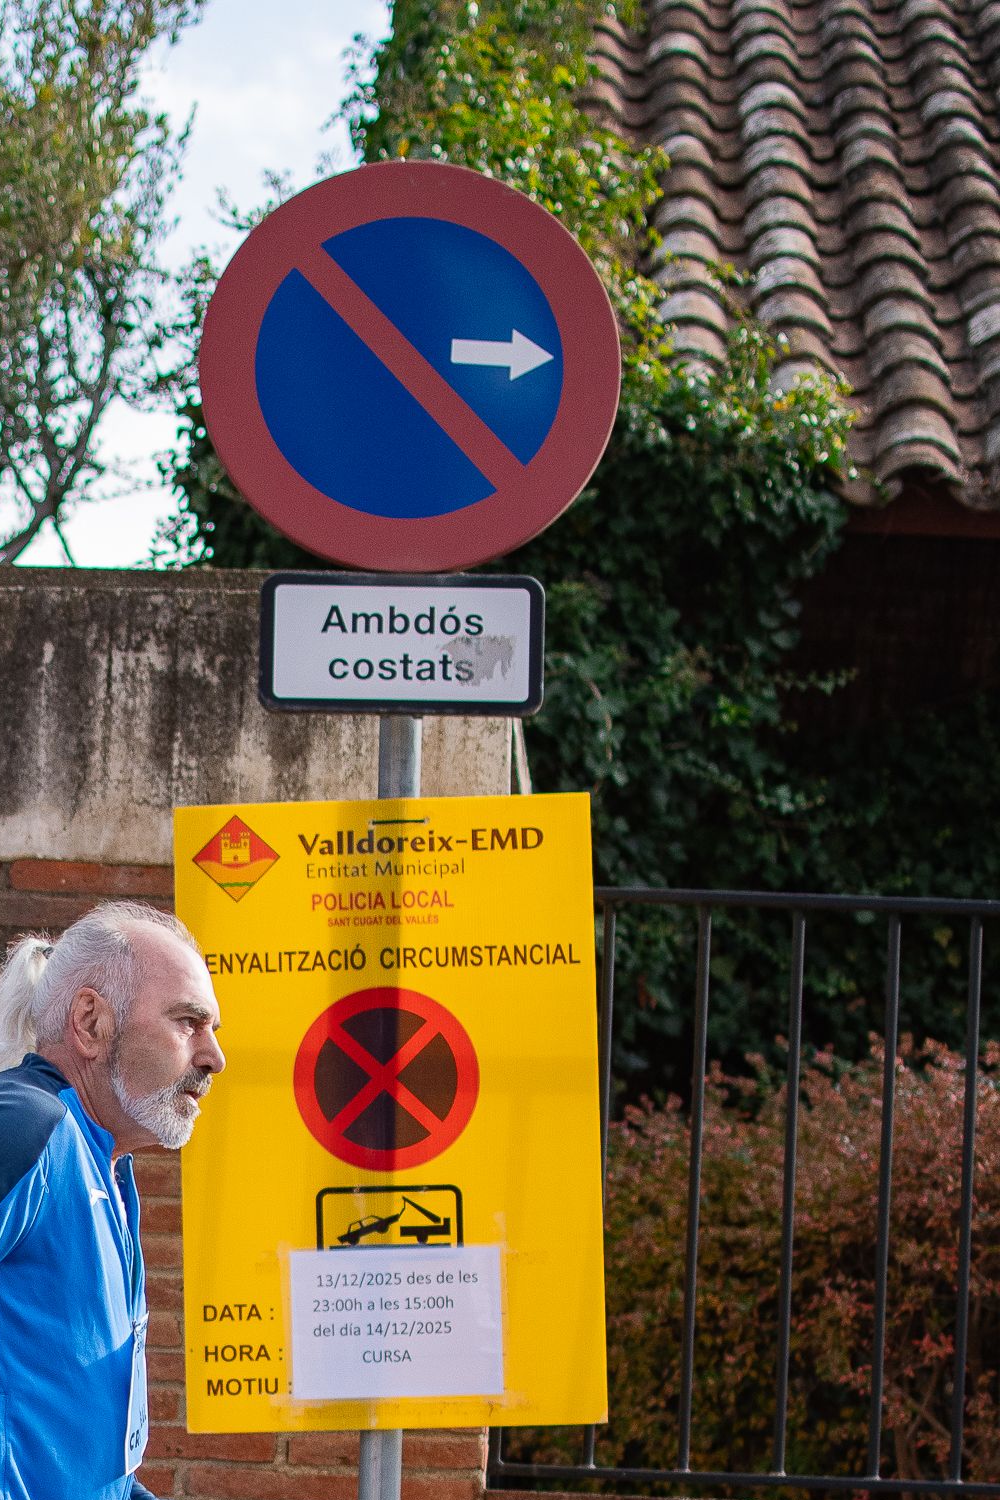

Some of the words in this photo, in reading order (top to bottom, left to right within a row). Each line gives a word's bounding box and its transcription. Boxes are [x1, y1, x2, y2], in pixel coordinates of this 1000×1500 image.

[321, 603, 485, 636] Ambdós
[328, 652, 476, 682] costats
[297, 827, 545, 856] Valldoreix-EMD
[306, 862, 367, 880] Entitat
[374, 858, 466, 879] Municipal
[311, 891, 386, 912] POLICIA
[391, 890, 455, 909] LOCAL
[327, 917, 351, 928] SANT
[353, 916, 383, 927] CUGAT
[385, 915, 401, 926] DEL
[204, 943, 367, 975] ENYALITZACIÓ
[379, 943, 582, 969] CIRCUMSTANCIAL
[316, 1272, 403, 1288] 13/12/2025
[406, 1271, 432, 1285] des
[436, 1270, 454, 1285] de
[458, 1270, 479, 1284] les
[312, 1298, 363, 1313] 23:00h
[367, 1301, 376, 1312] a
[379, 1297, 400, 1311] les
[404, 1296, 454, 1310] 15:00h
[313, 1323, 335, 1337] del
[339, 1322, 362, 1337] día
[365, 1320, 453, 1336] 14/12/2025
[361, 1349, 413, 1364] CURSA
